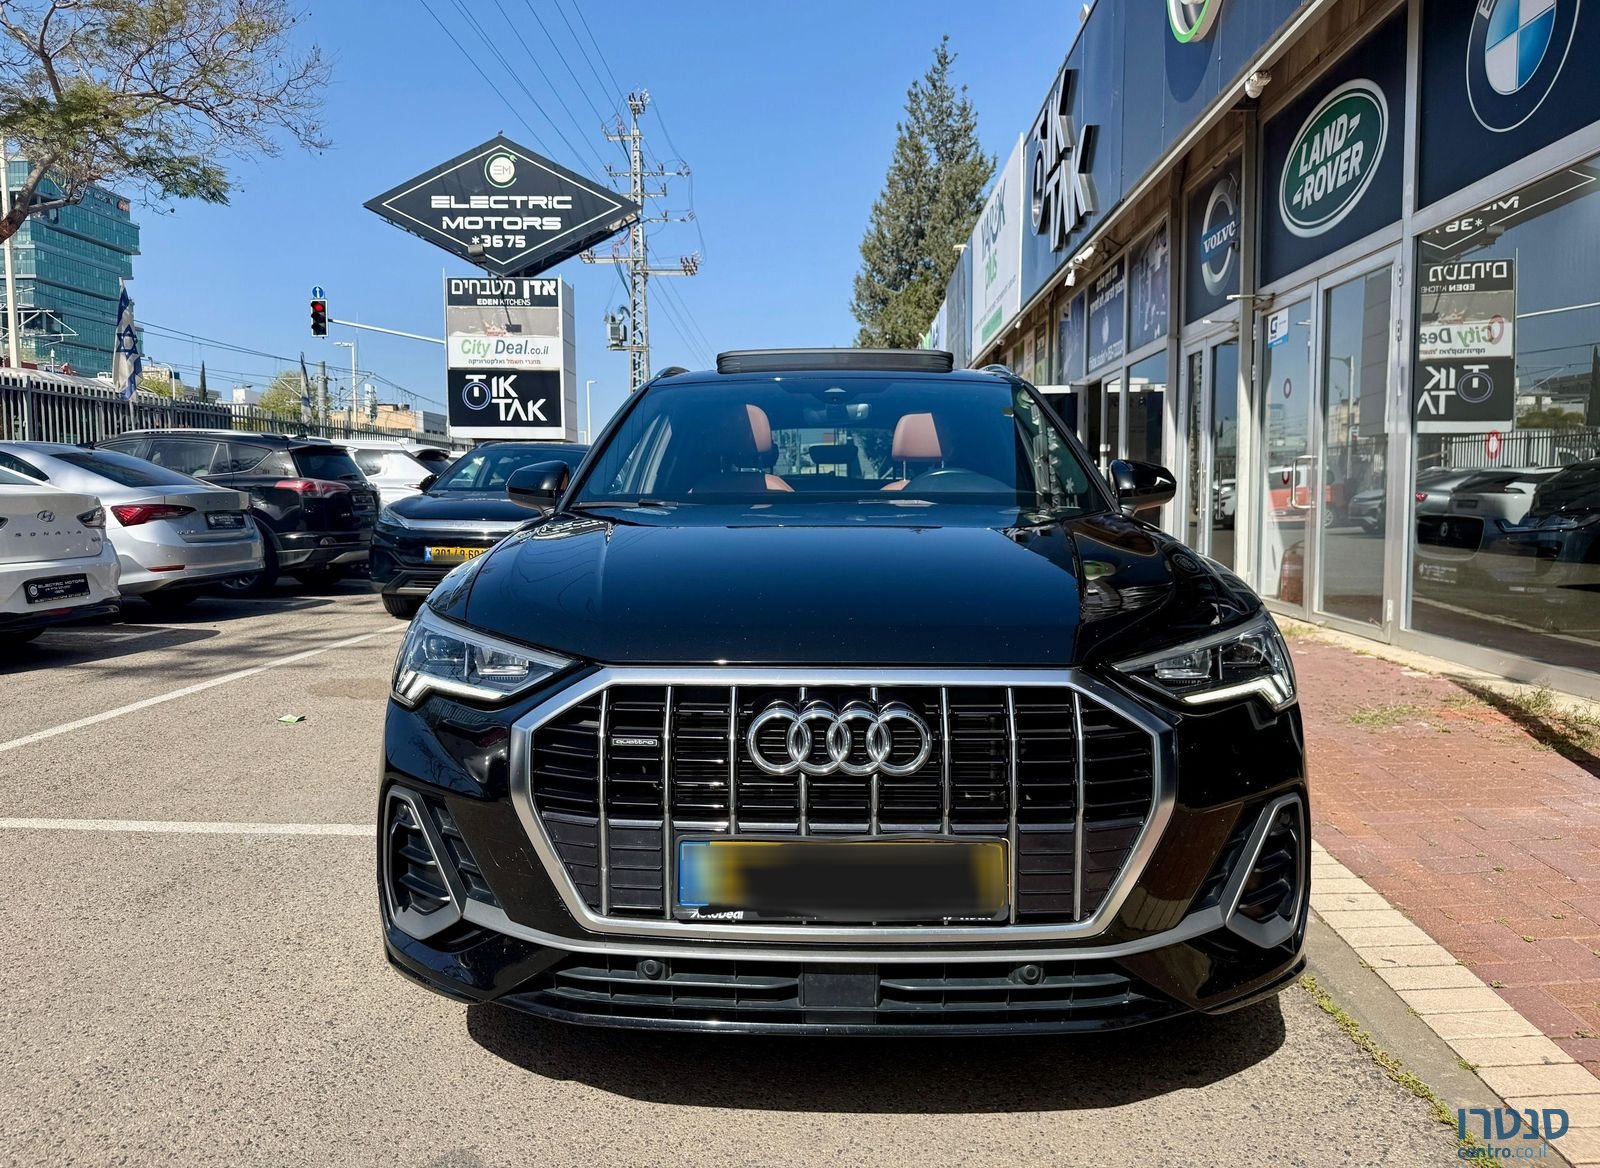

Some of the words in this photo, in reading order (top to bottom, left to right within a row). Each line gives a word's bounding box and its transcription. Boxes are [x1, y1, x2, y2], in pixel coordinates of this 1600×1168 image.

[1298, 113, 1349, 178] LAND
[1301, 140, 1364, 210] ROVER
[1046, 124, 1093, 252] TAK
[430, 195, 572, 209] ELECTRIC
[442, 216, 562, 230] MOTORS
[451, 279, 516, 295] מטבחים
[523, 280, 556, 298] אדן
[461, 339, 491, 358] City
[495, 339, 549, 355] Deal.co.il
[492, 398, 548, 421] TAK
